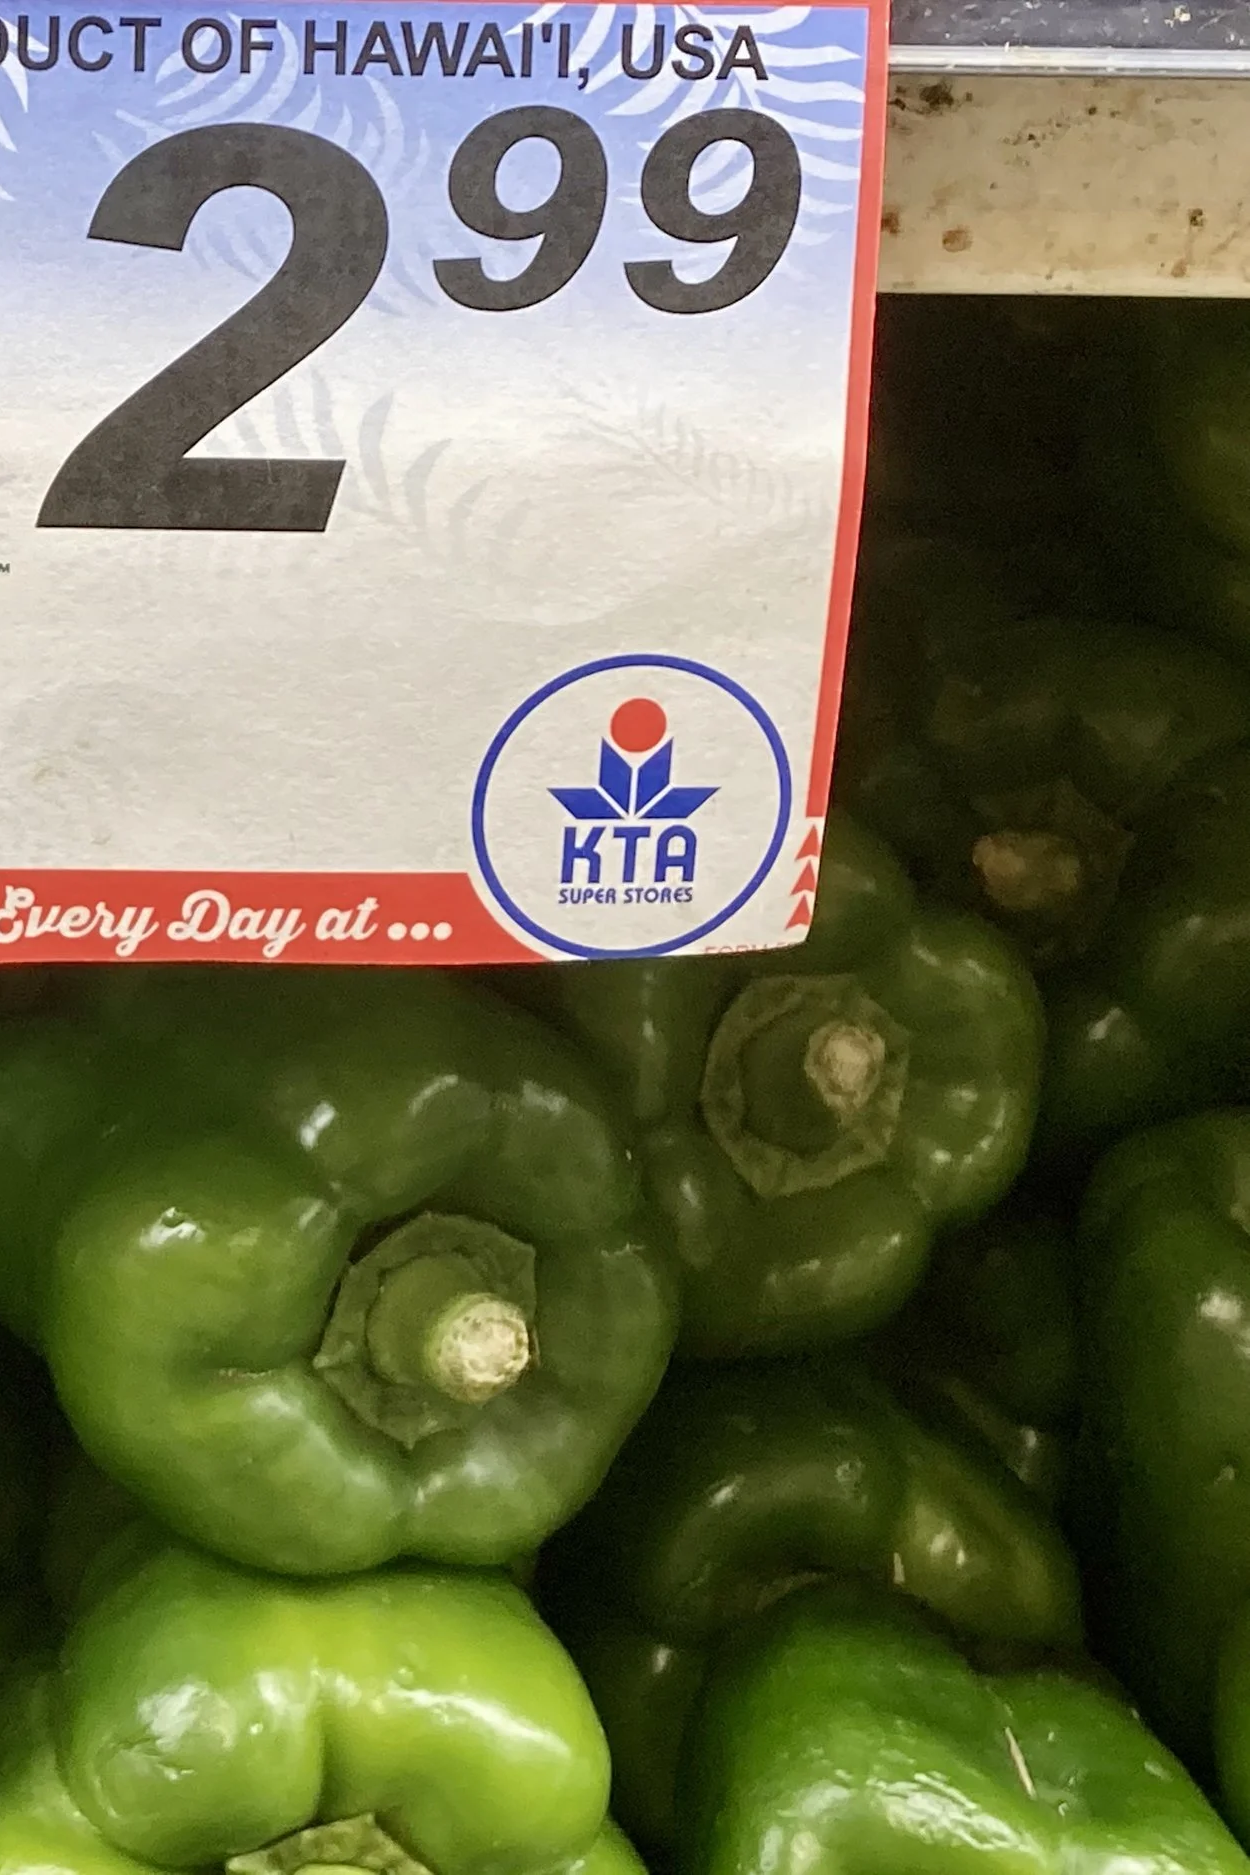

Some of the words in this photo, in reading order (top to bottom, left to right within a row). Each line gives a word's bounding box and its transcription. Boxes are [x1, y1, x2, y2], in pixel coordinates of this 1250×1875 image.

[180, 18, 277, 76] OF
[620, 24, 769, 82] USA
[559, 824, 698, 885] KTA
[165, 888, 306, 959] Day
[557, 887, 617, 905] SUPER
[622, 886, 694, 905] STORES
